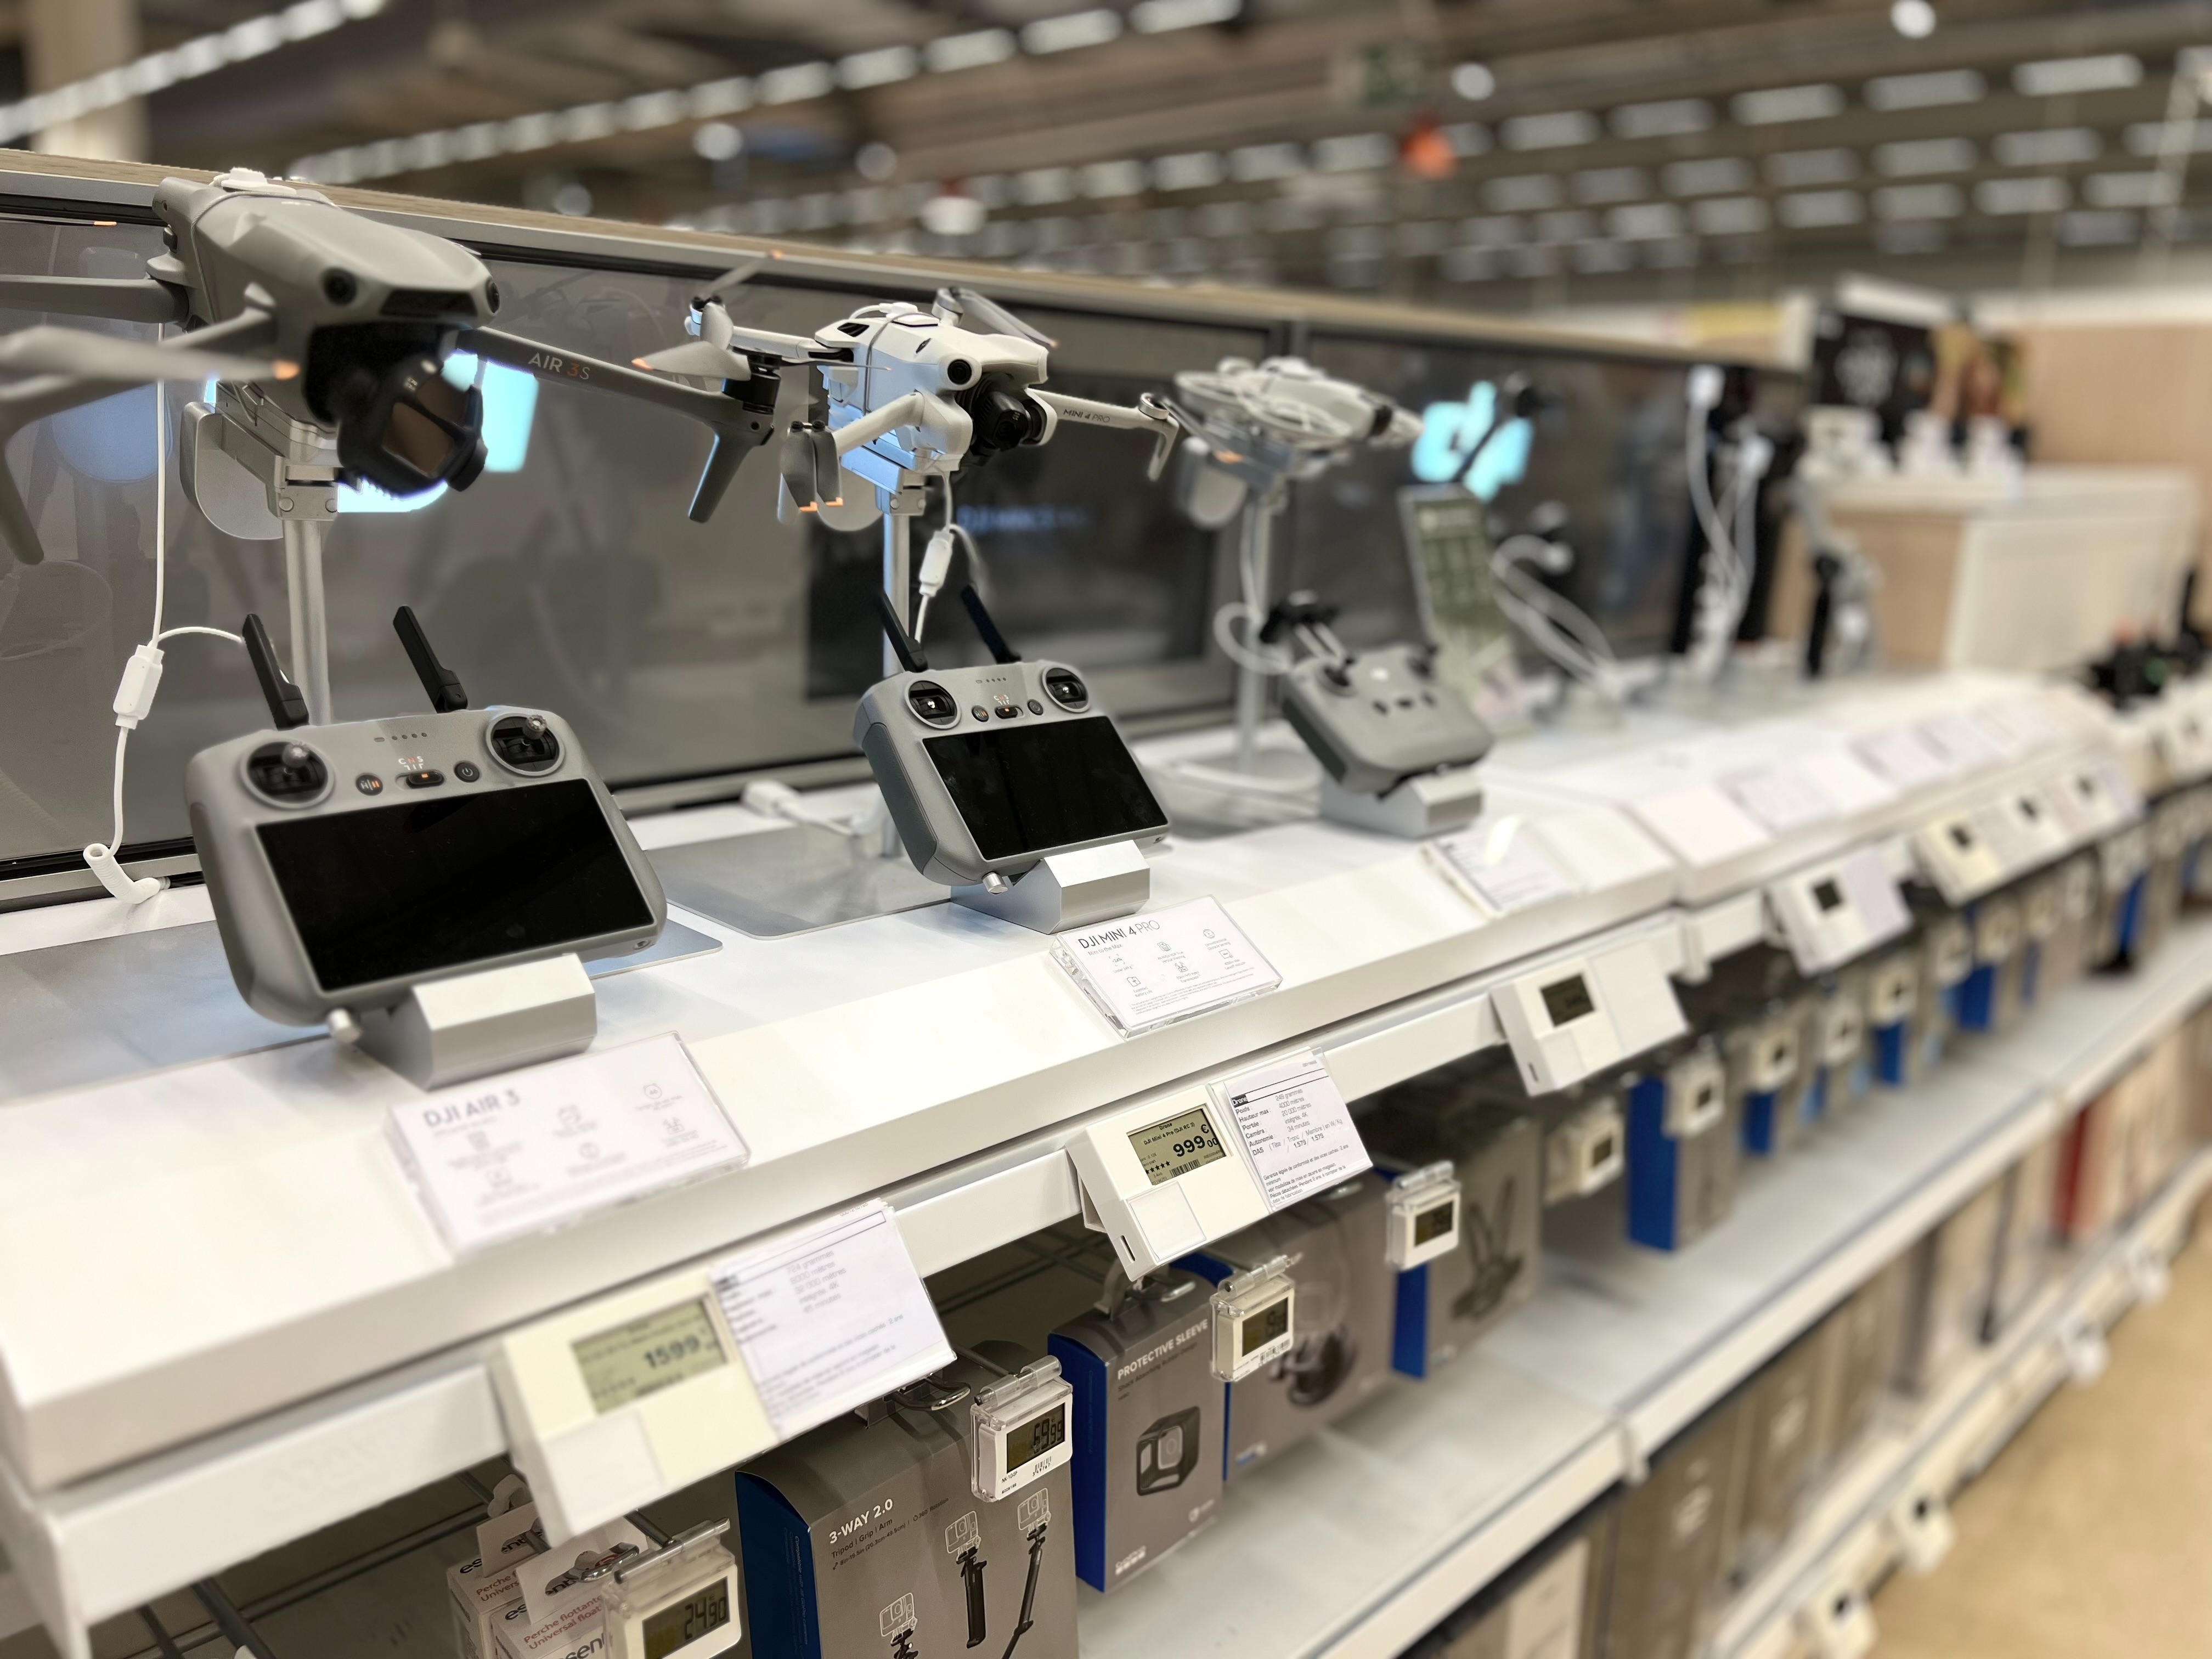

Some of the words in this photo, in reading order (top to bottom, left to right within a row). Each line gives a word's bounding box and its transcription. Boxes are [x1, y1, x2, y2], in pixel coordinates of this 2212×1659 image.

[528, 352, 563, 373] AIR
[567, 363, 590, 380] 3S
[1063, 409, 1084, 418] MINI
[1092, 414, 1110, 422] PRO
[1077, 935, 1101, 949] DJI
[1097, 928, 1127, 944] MINI
[1128, 926, 1137, 936] 4
[1135, 920, 1160, 934] PRO
[422, 1103, 461, 1128] DJI
[465, 1093, 501, 1118] AIR
[1232, 1096, 1248, 1106] Drone
[1235, 1106, 1250, 1115] Poids
[1275, 1093, 1285, 1102] 249
[1284, 1088, 1303, 1099] grammes
[1239, 1112, 1259, 1123] Hauteur
[1279, 1100, 1290, 1109] 4000
[1159, 1122, 1173, 1131] Drone
[1200, 1124, 1210, 1134] €
[1242, 1121, 1260, 1131] Portée
[1289, 1106, 1297, 1114] 000
[1245, 1128, 1265, 1139] Caméra
[1249, 1134, 1274, 1147] Autonomie
[1287, 1124, 1294, 1132] 34
[1294, 1120, 1310, 1130] minutes
[1252, 1147, 1265, 1156] DAS
[1286, 1133, 1300, 1143] Tronc
[1305, 1126, 1322, 1137] Membre
[1311, 1132, 1324, 1142] 1.579
[1172, 1135, 1206, 1158] 999
[786, 1263, 802, 1276] 724
[802, 1250, 834, 1270] grammes
[811, 1261, 836, 1276] mètres
[822, 1268, 847, 1283] mètres
[829, 1280, 840, 1290] 4K
[815, 1292, 842, 1309] minutes
[894, 1314, 904, 1322] ans
[1117, 1339, 1175, 1380] PROTECTIVE
[1176, 1318, 1208, 1346] SLEEVE
[929, 1497, 949, 1513] Rotation
[829, 1510, 870, 1544] 3-WAY
[873, 1498, 894, 1519] 2.0
[831, 1541, 854, 1559] Tripod
[859, 1529, 874, 1542] Grip
[878, 1519, 893, 1531] Arm
[460, 1558, 482, 1573] es
[476, 1576, 511, 1596] Perche
[481, 1580, 520, 1601] Univers
[505, 1604, 527, 1620] es
[524, 1620, 560, 1644] Perche
[529, 1620, 577, 1650] Universal
[577, 1605, 602, 1623] float
